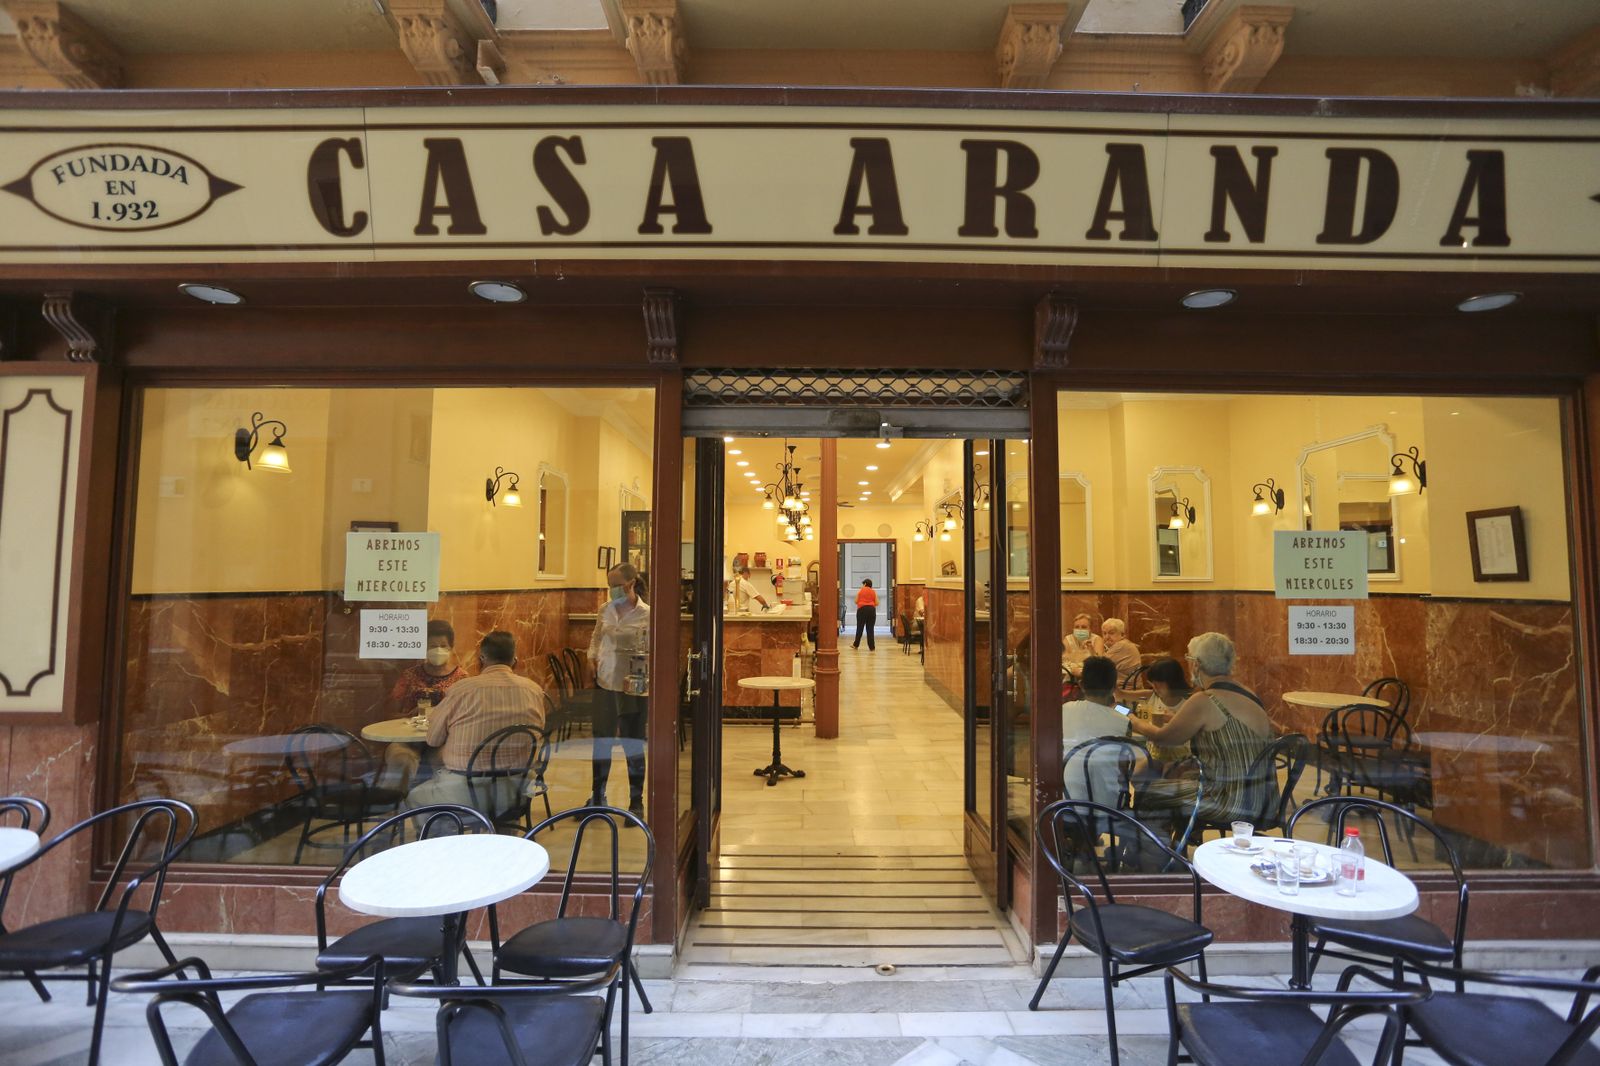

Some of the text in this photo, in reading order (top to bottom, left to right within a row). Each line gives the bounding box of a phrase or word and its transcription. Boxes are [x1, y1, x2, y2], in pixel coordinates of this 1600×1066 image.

[51, 153, 189, 185] FUNDADA
[105, 180, 137, 196] EN
[306, 134, 1512, 249] CASA ARANDA
[92, 200, 159, 222] 1.932
[366, 539, 420, 551] ABRIMOS
[1292, 537, 1346, 549] ABRIMOS
[378, 559, 408, 571] ESTE
[1304, 557, 1334, 569] ESTE
[357, 580, 427, 592] MIERCOLES
[1285, 578, 1354, 590] MIERCOLES
[379, 613, 410, 621] HORARIO
[1306, 609, 1337, 617] HORARIO
[369, 625, 388, 633] 9:30
[396, 625, 420, 633] 13:30
[1297, 622, 1315, 630] 9:30
[1323, 622, 1347, 630] 13:30
[366, 640, 390, 648] 18:30
[398, 640, 422, 648] 20:30
[1294, 637, 1318, 645] 18:30
[1325, 637, 1349, 645] 20:30
